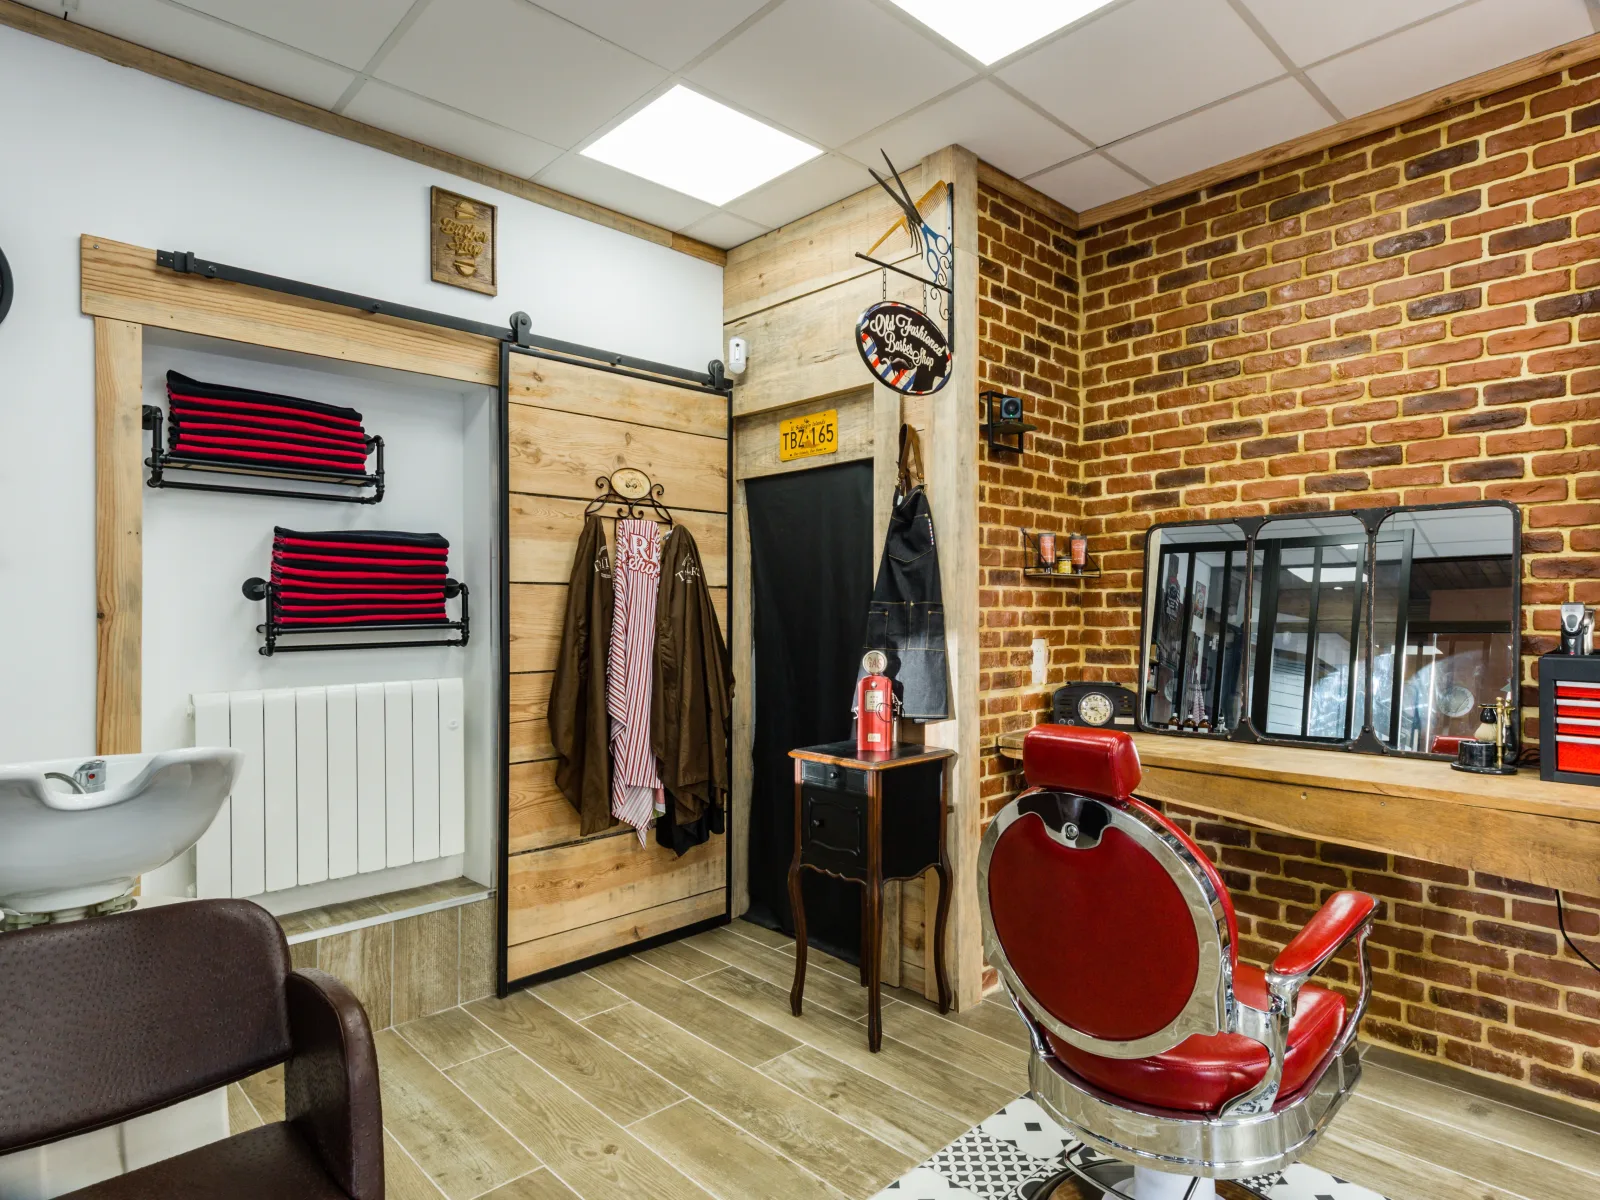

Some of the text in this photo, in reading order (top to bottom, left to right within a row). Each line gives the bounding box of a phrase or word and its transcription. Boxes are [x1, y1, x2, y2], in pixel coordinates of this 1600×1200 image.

[869, 313, 946, 357] Old Fashioned
[884, 330, 934, 372] Barber Shop
[867, 655, 883, 669] GAS
